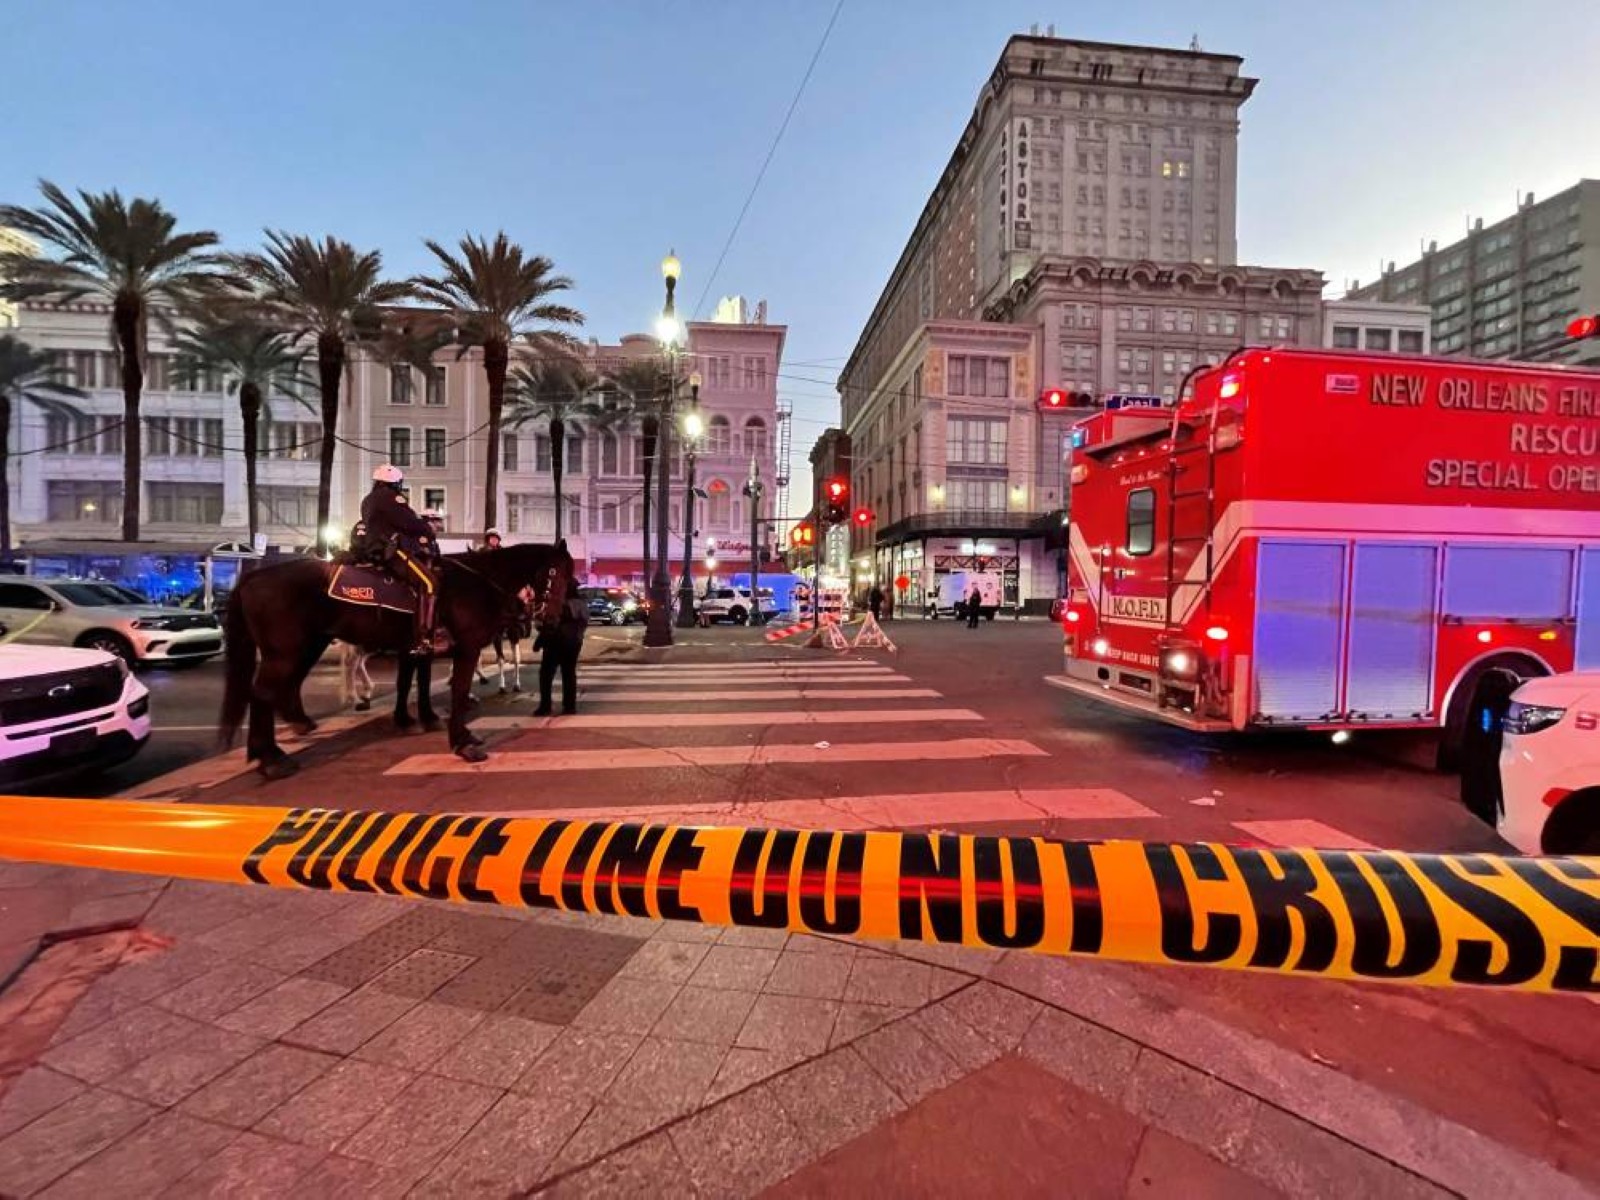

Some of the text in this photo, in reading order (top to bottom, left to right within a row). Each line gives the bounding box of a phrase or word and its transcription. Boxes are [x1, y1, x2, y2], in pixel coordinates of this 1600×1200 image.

[1371, 374, 1428, 405] NEW
[1438, 377, 1548, 415] ORLEANS
[1510, 422, 1597, 456] RESCU
[1426, 458, 1600, 493] SPECIAL OPE
[242, 807, 1600, 991] POLICE LINE DO NOT CROSS
